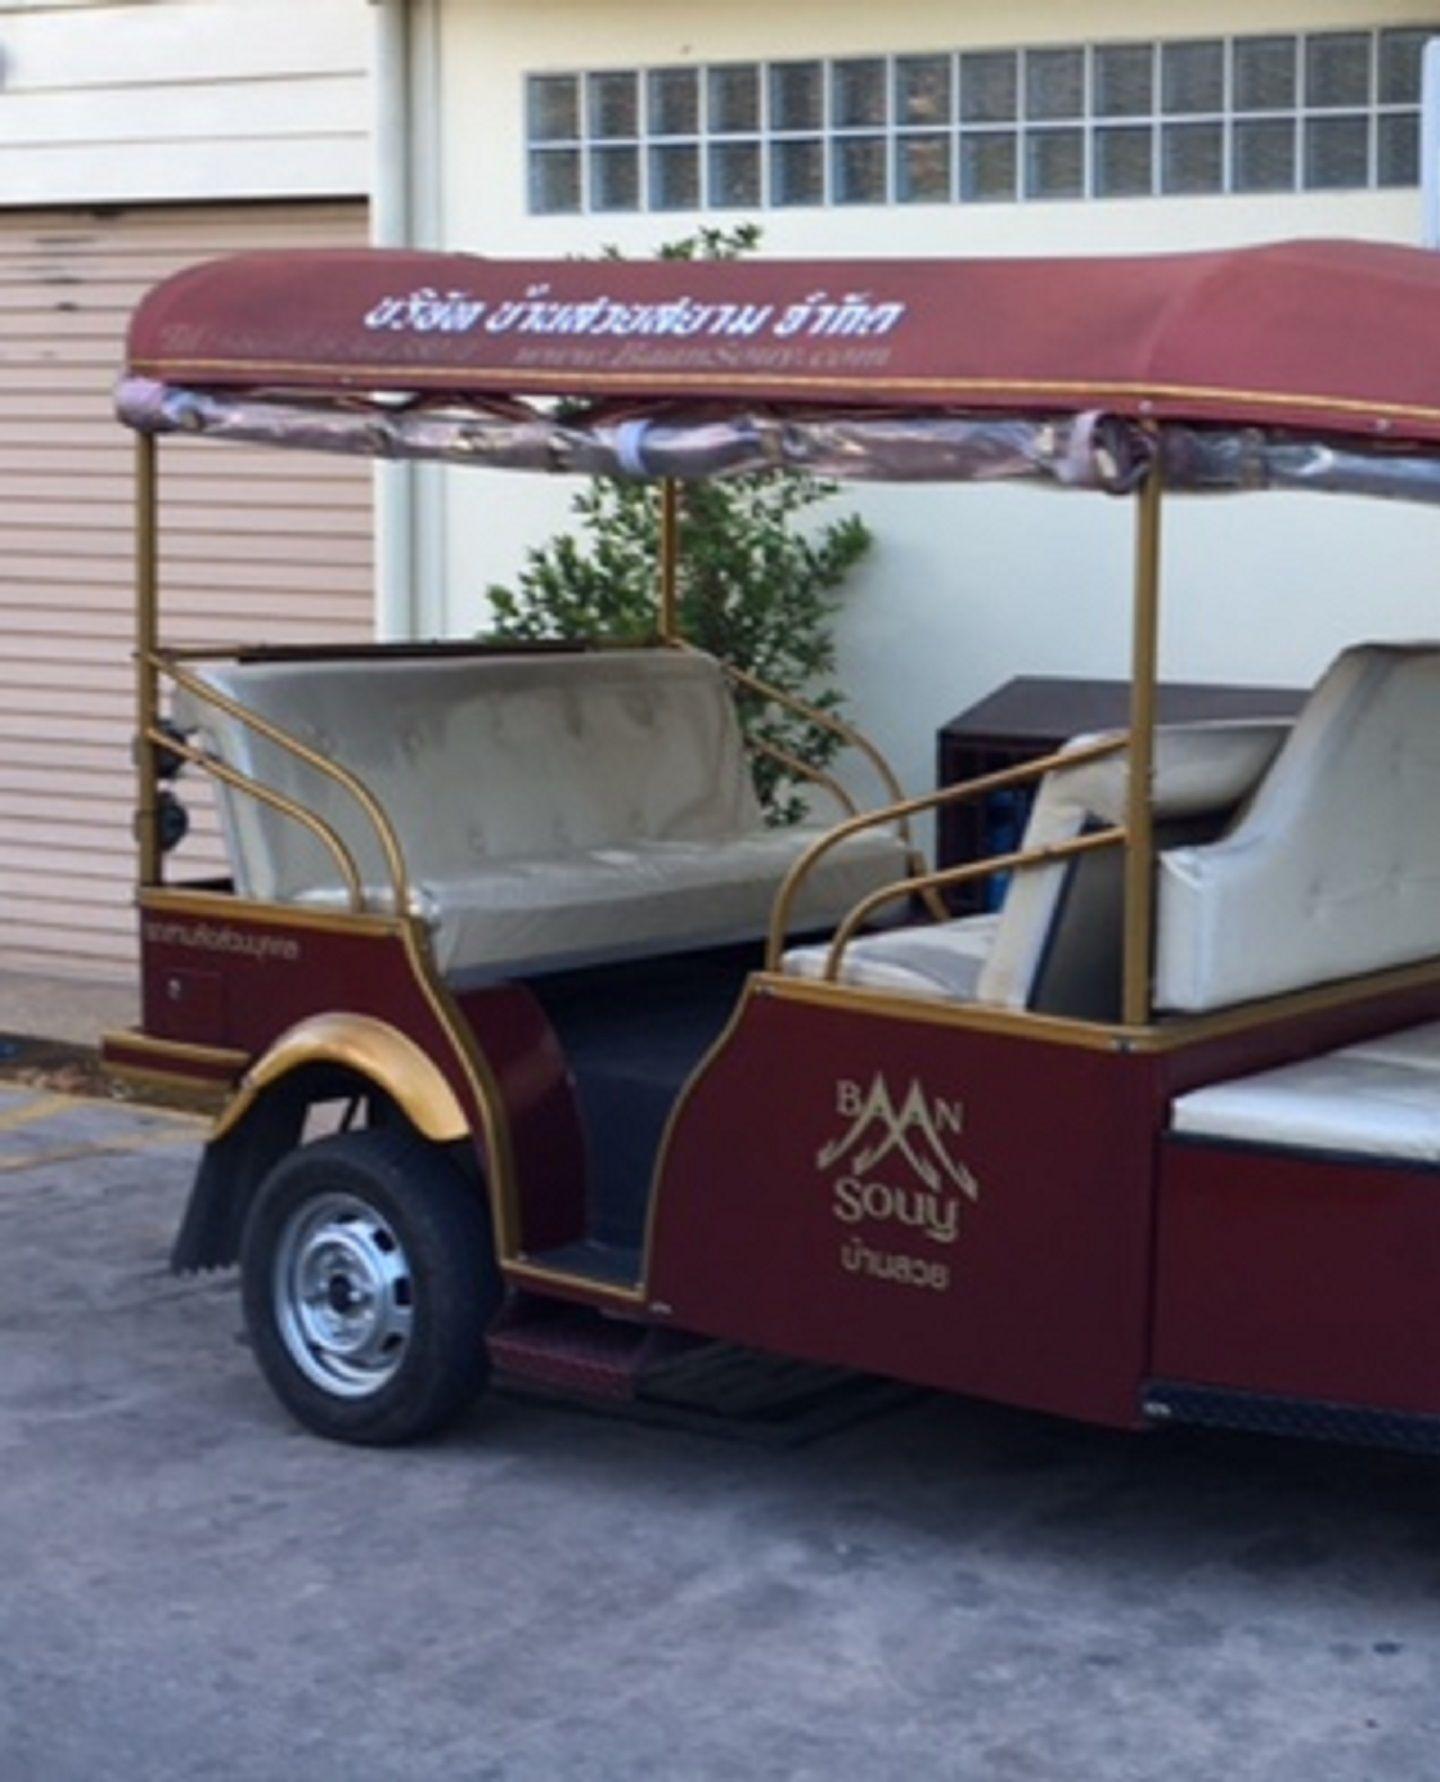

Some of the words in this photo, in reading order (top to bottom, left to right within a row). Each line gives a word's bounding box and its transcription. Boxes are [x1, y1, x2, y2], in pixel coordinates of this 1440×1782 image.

[364, 287, 487, 331] บริษัท
[773, 290, 906, 338] จำกัด
[841, 1236, 952, 1292] บ้านสวย
